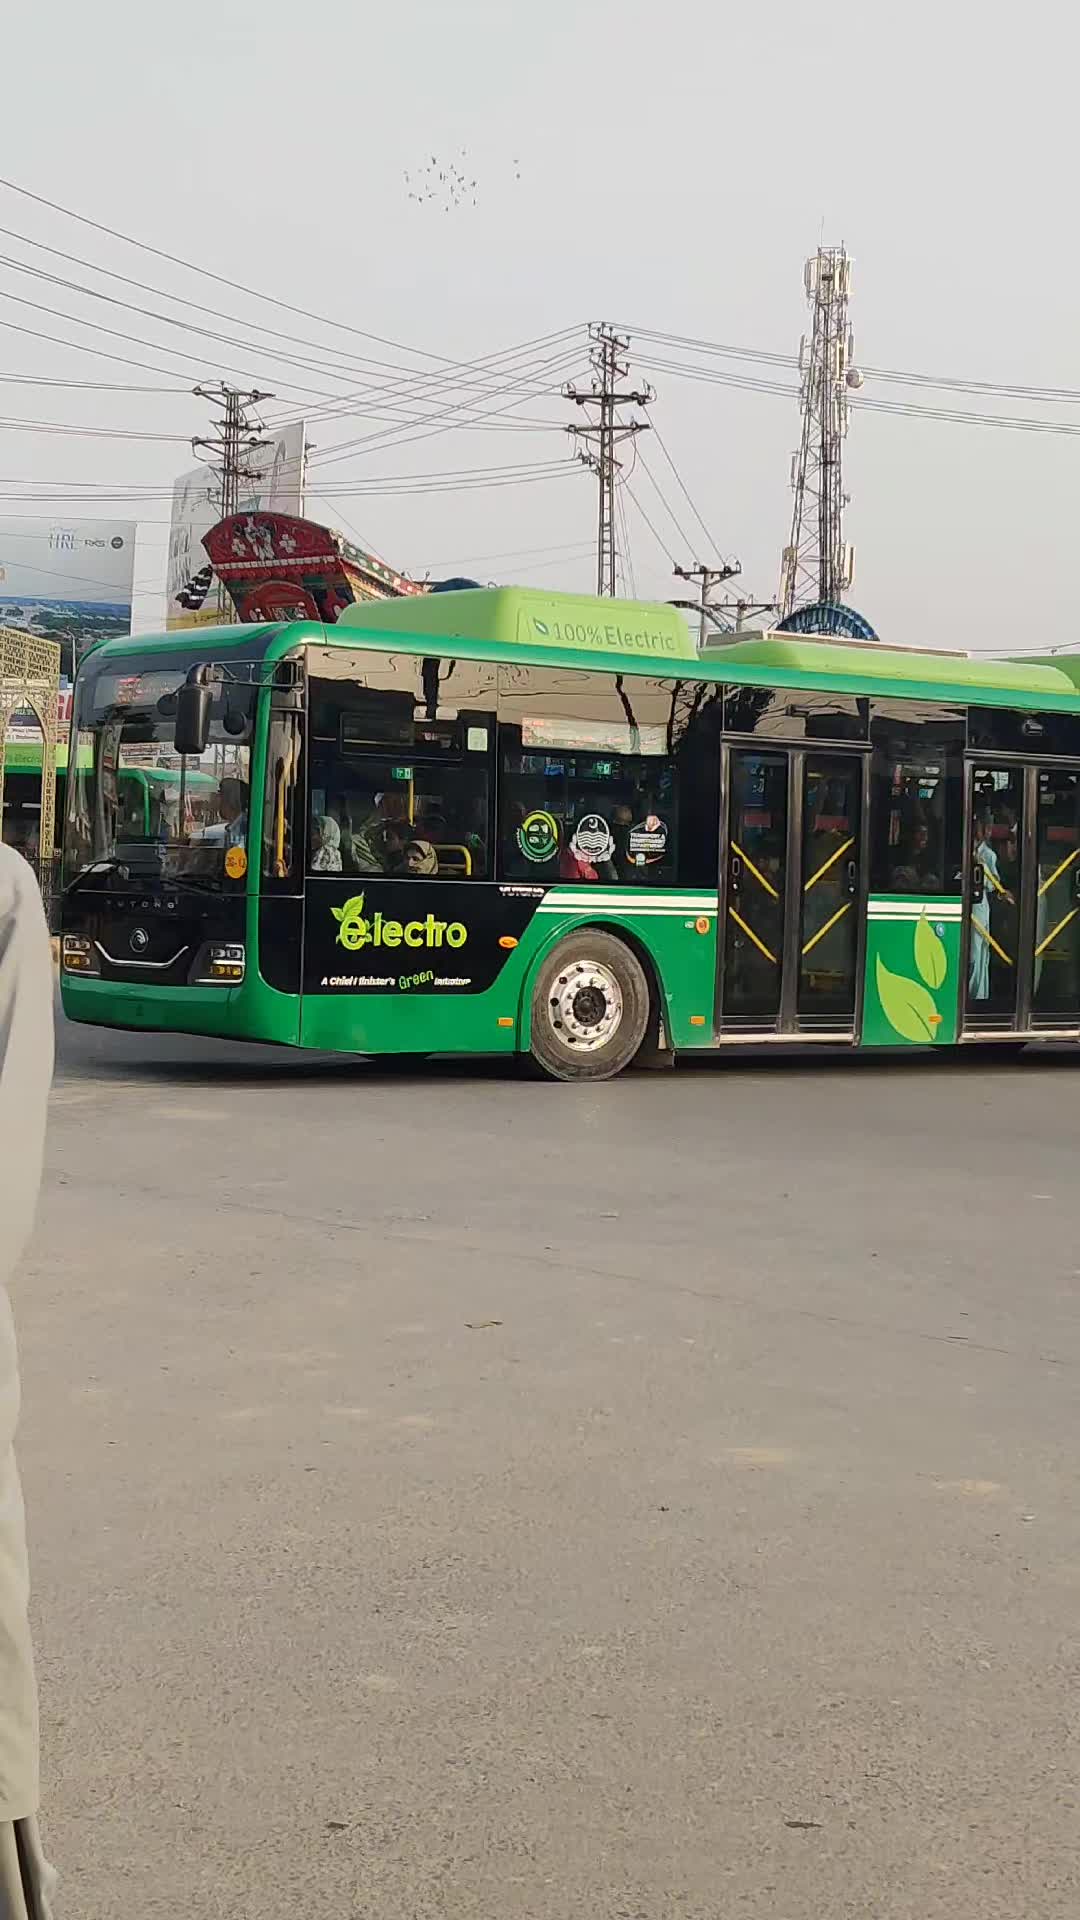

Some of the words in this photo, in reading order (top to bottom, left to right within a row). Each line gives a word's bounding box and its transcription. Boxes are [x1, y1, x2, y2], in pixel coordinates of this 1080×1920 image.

[553, 622, 601, 644] 100%
[604, 625, 676, 650] Electric
[339, 912, 468, 950] electro
[320, 976, 328, 986] A
[399, 970, 433, 989] Green
